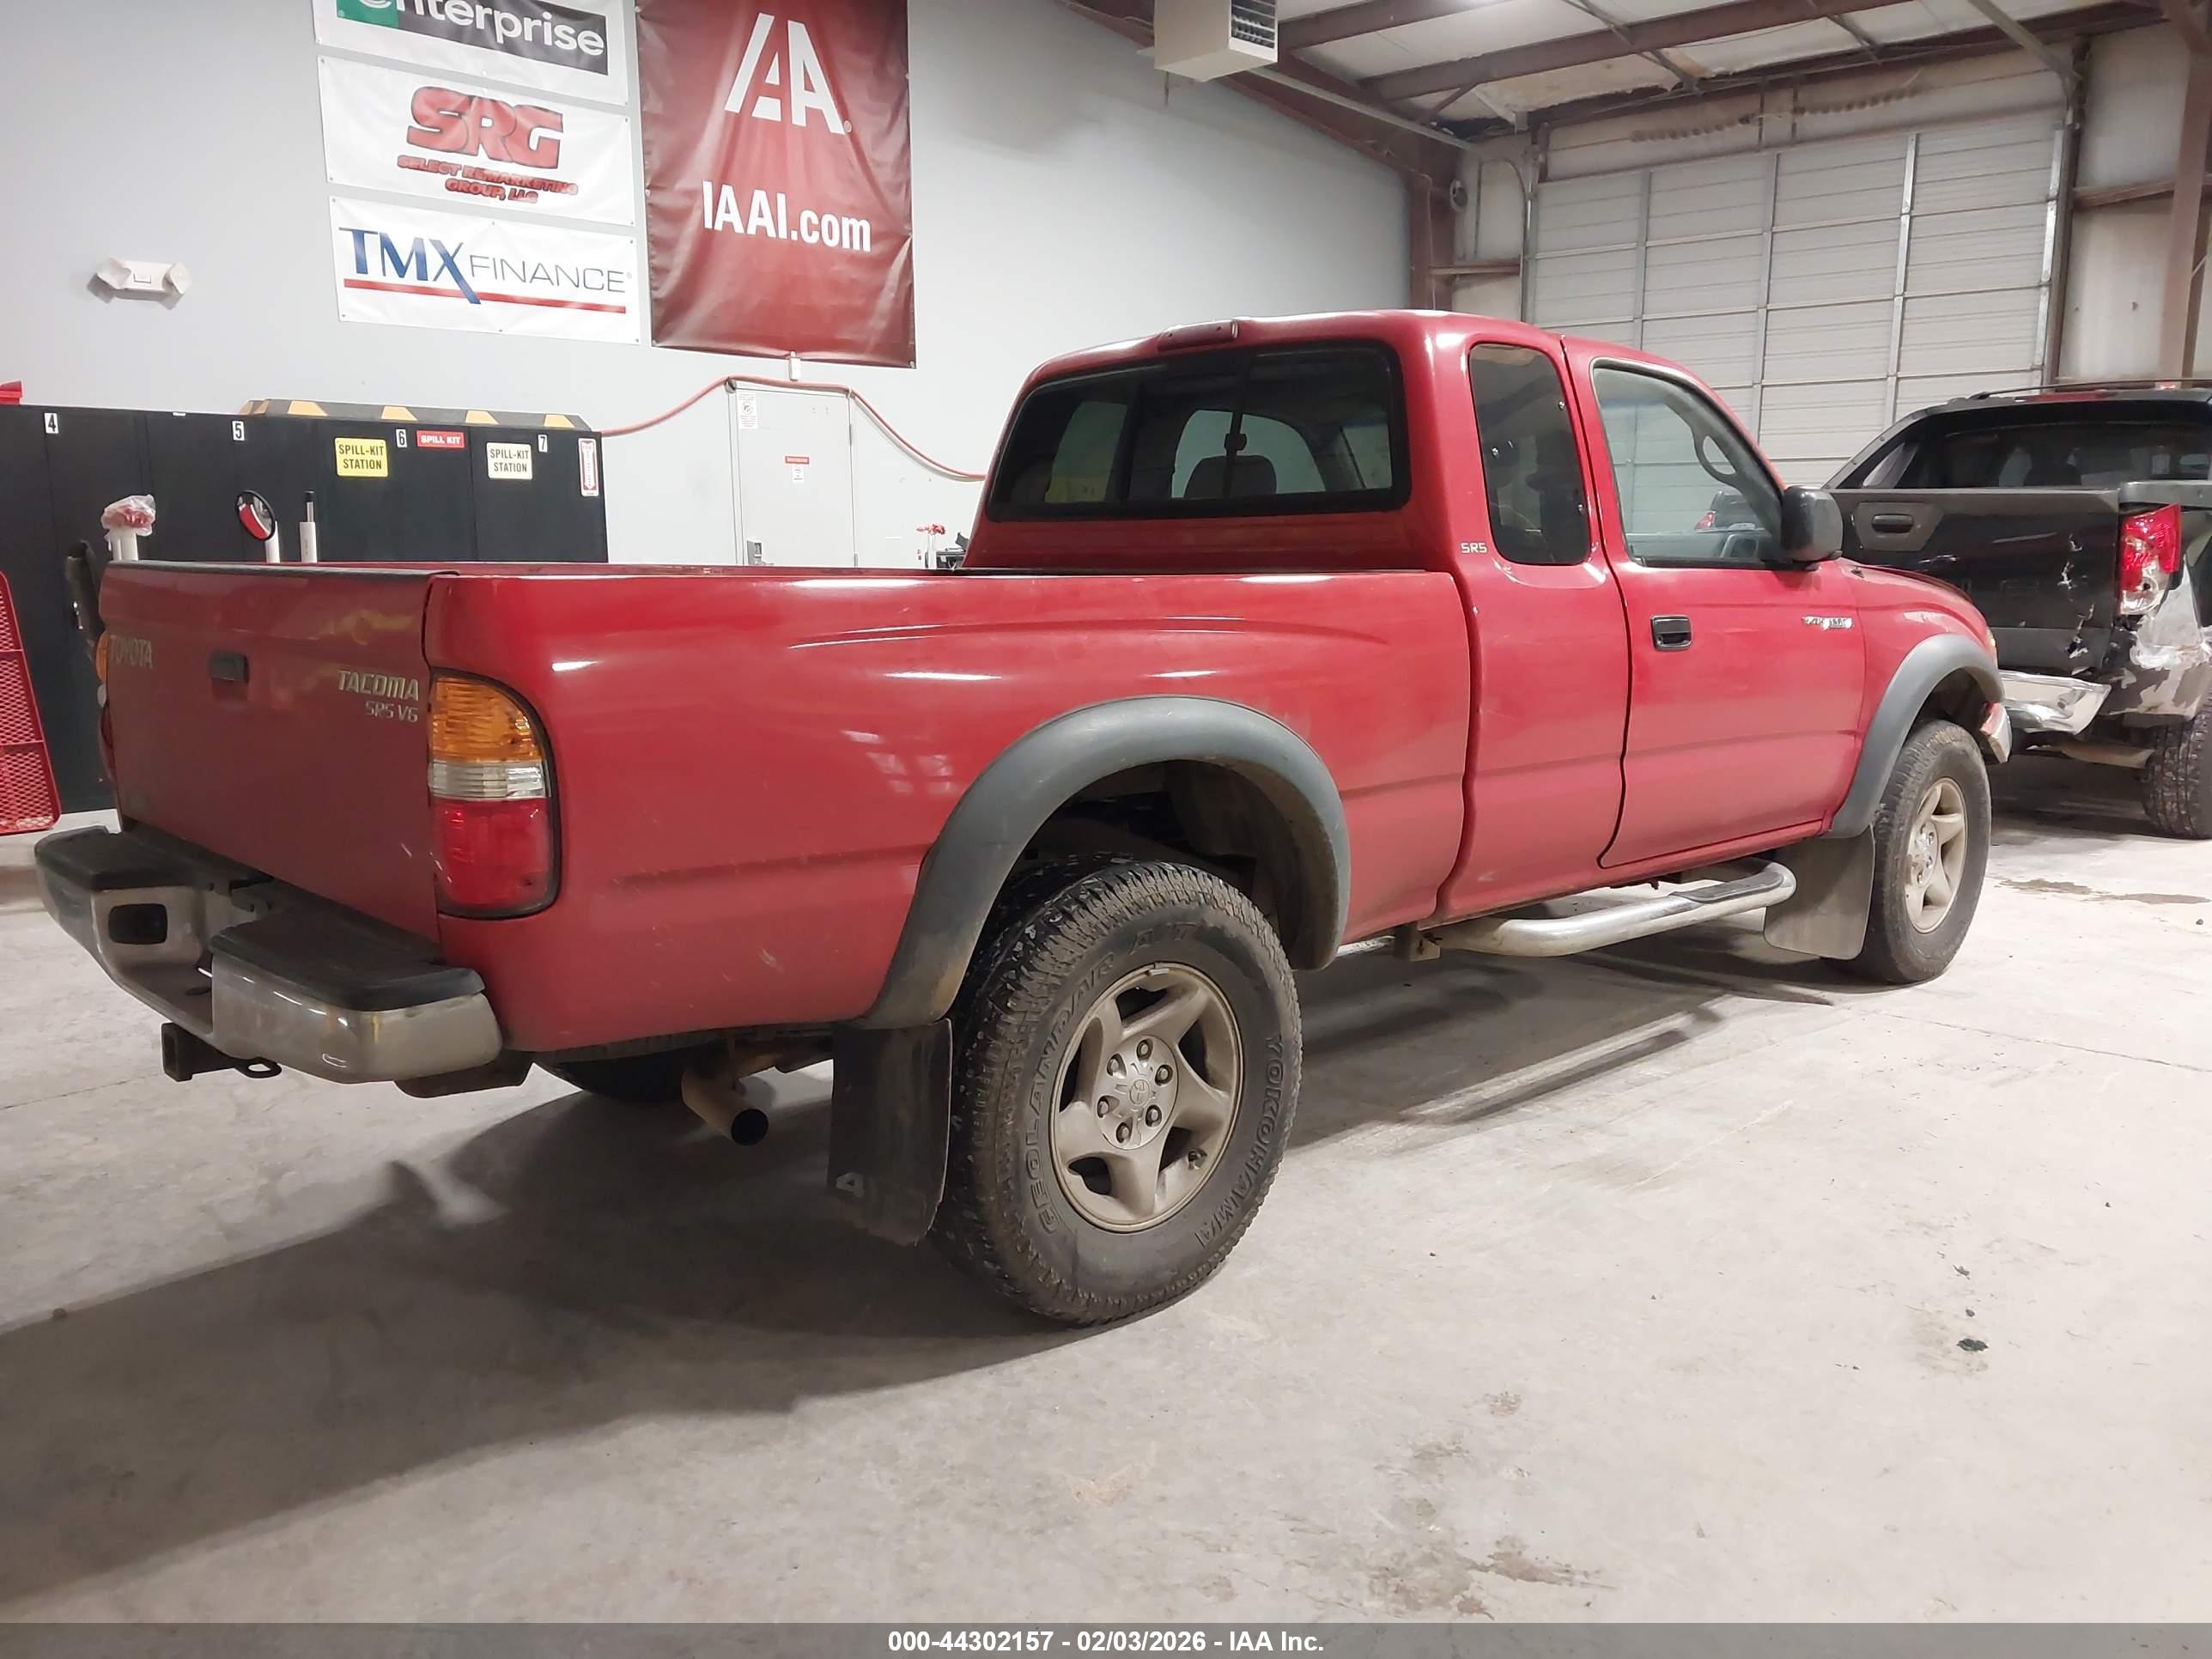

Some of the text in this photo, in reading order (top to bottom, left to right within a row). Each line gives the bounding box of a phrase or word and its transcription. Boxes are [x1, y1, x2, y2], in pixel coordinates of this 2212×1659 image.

[406, 86, 563, 169] SRG
[398, 155, 579, 195] SELECT REMARKETING
[445, 178, 538, 204] GROUP, LLC
[702, 180, 872, 252] IAAI.com
[338, 226, 627, 305] TMX FINANCE
[47, 414, 57, 433] 4
[234, 422, 243, 439] 5
[398, 430, 405, 446] 6
[421, 434, 461, 445] SPILL KIT
[540, 435, 547, 451] 7
[338, 443, 385, 457] SPILL-KIT
[489, 447, 529, 460] SPILL-KIT
[343, 458, 382, 471] STATION
[493, 461, 527, 473] STATION
[1461, 542, 1487, 554] SR5
[109, 634, 154, 670] TOYOTA
[337, 670, 419, 702] TACOMA
[398, 703, 419, 723] V6
[1194, 1035, 1285, 1249] YOKOHAMA
